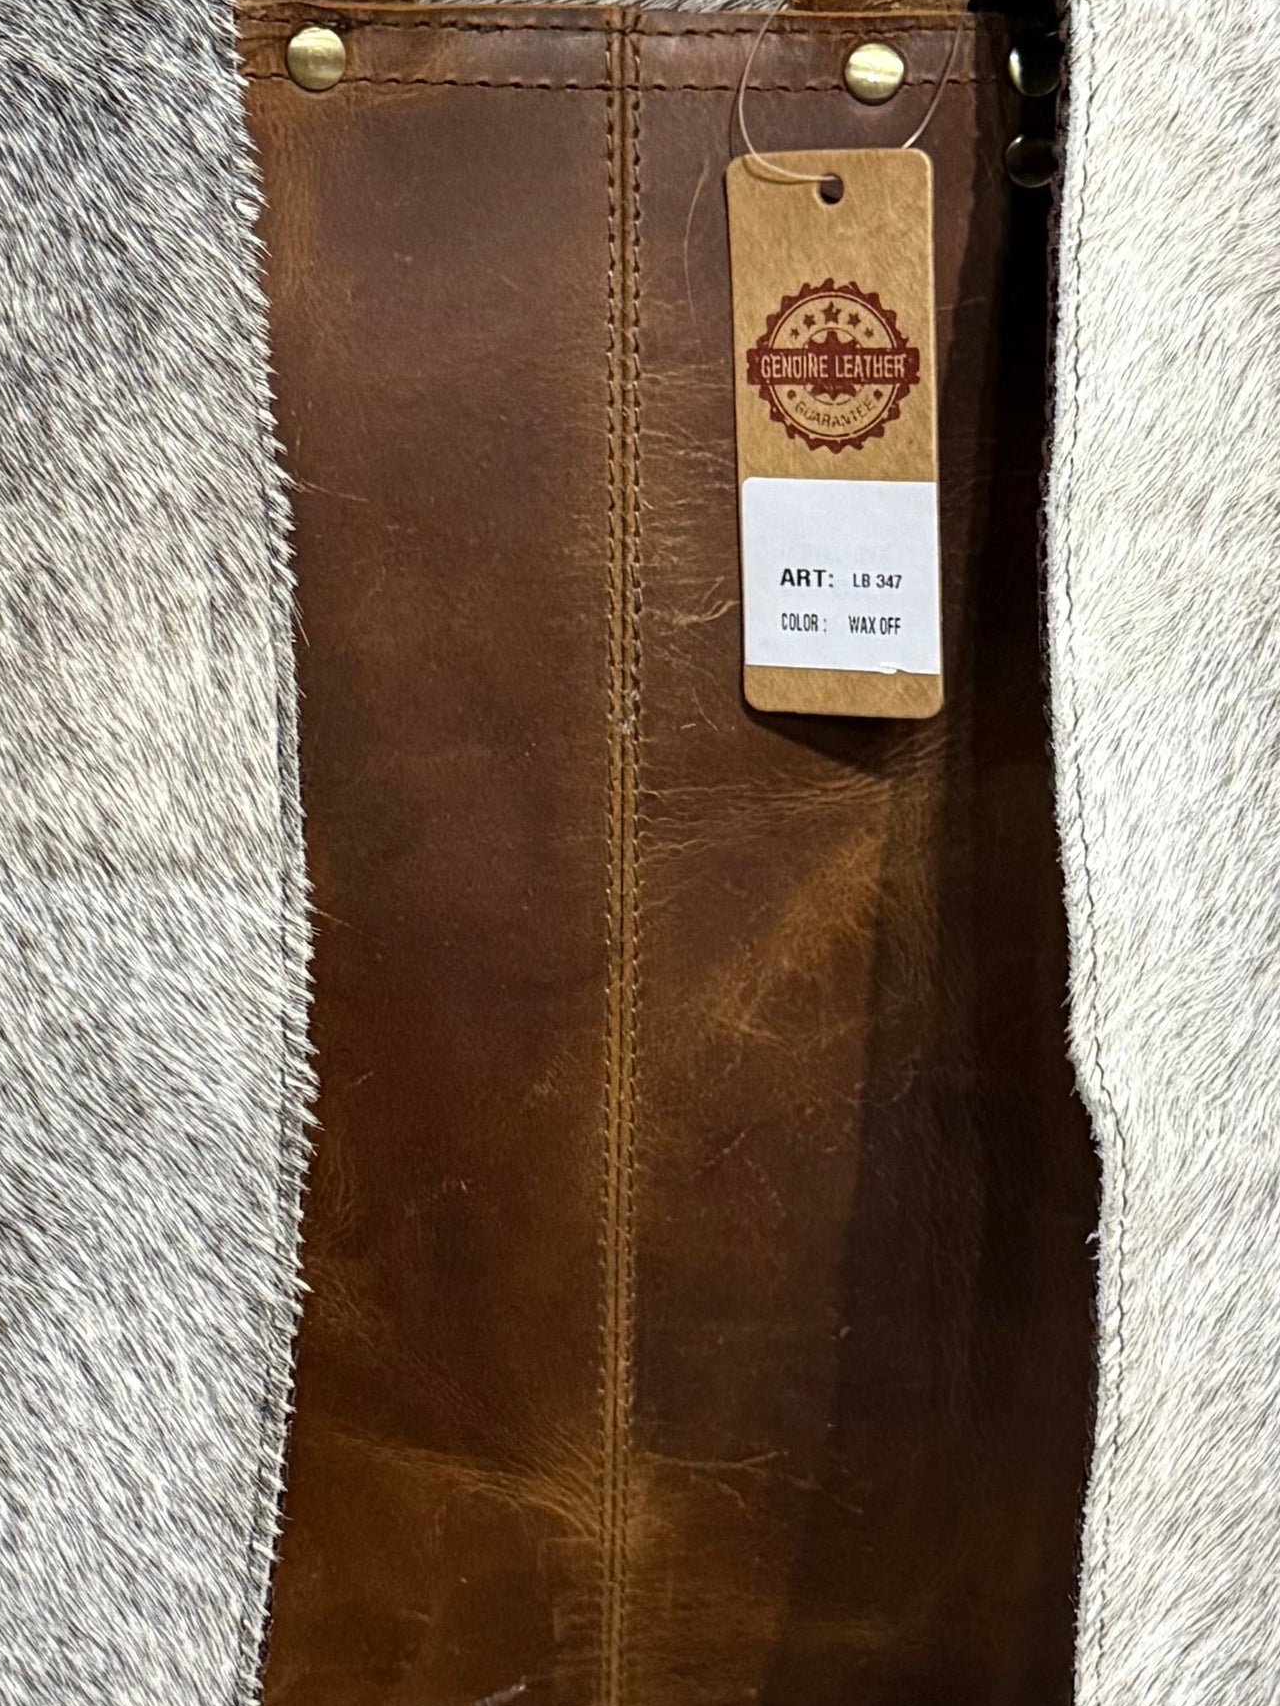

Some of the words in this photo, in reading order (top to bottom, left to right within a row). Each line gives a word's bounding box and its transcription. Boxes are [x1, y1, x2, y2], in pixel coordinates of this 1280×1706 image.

[760, 353, 829, 379] GENUINE
[835, 354, 907, 379] LEATHER
[794, 398, 876, 428] GUARANTEE
[780, 568, 834, 589] ART:
[852, 572, 871, 589] LB
[876, 574, 903, 590] 347
[848, 615, 877, 635] WAX
[879, 617, 902, 636] OFF
